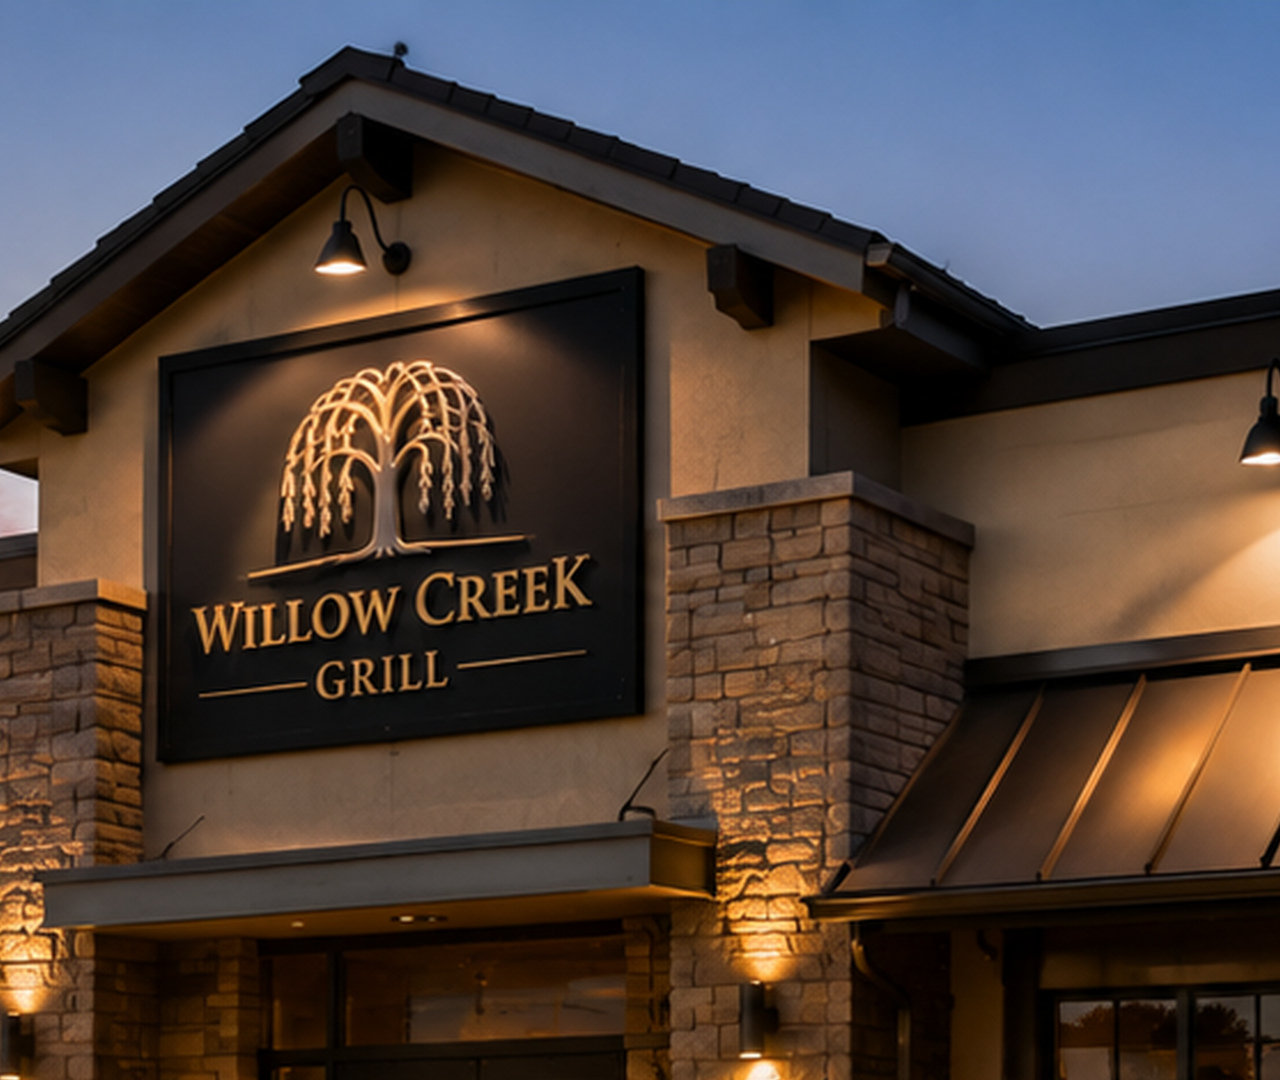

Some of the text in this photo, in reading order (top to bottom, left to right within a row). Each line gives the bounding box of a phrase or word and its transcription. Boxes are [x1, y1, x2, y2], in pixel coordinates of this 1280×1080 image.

[192, 554, 592, 654] WILLOW CREEK
[316, 651, 448, 699] GRILL
